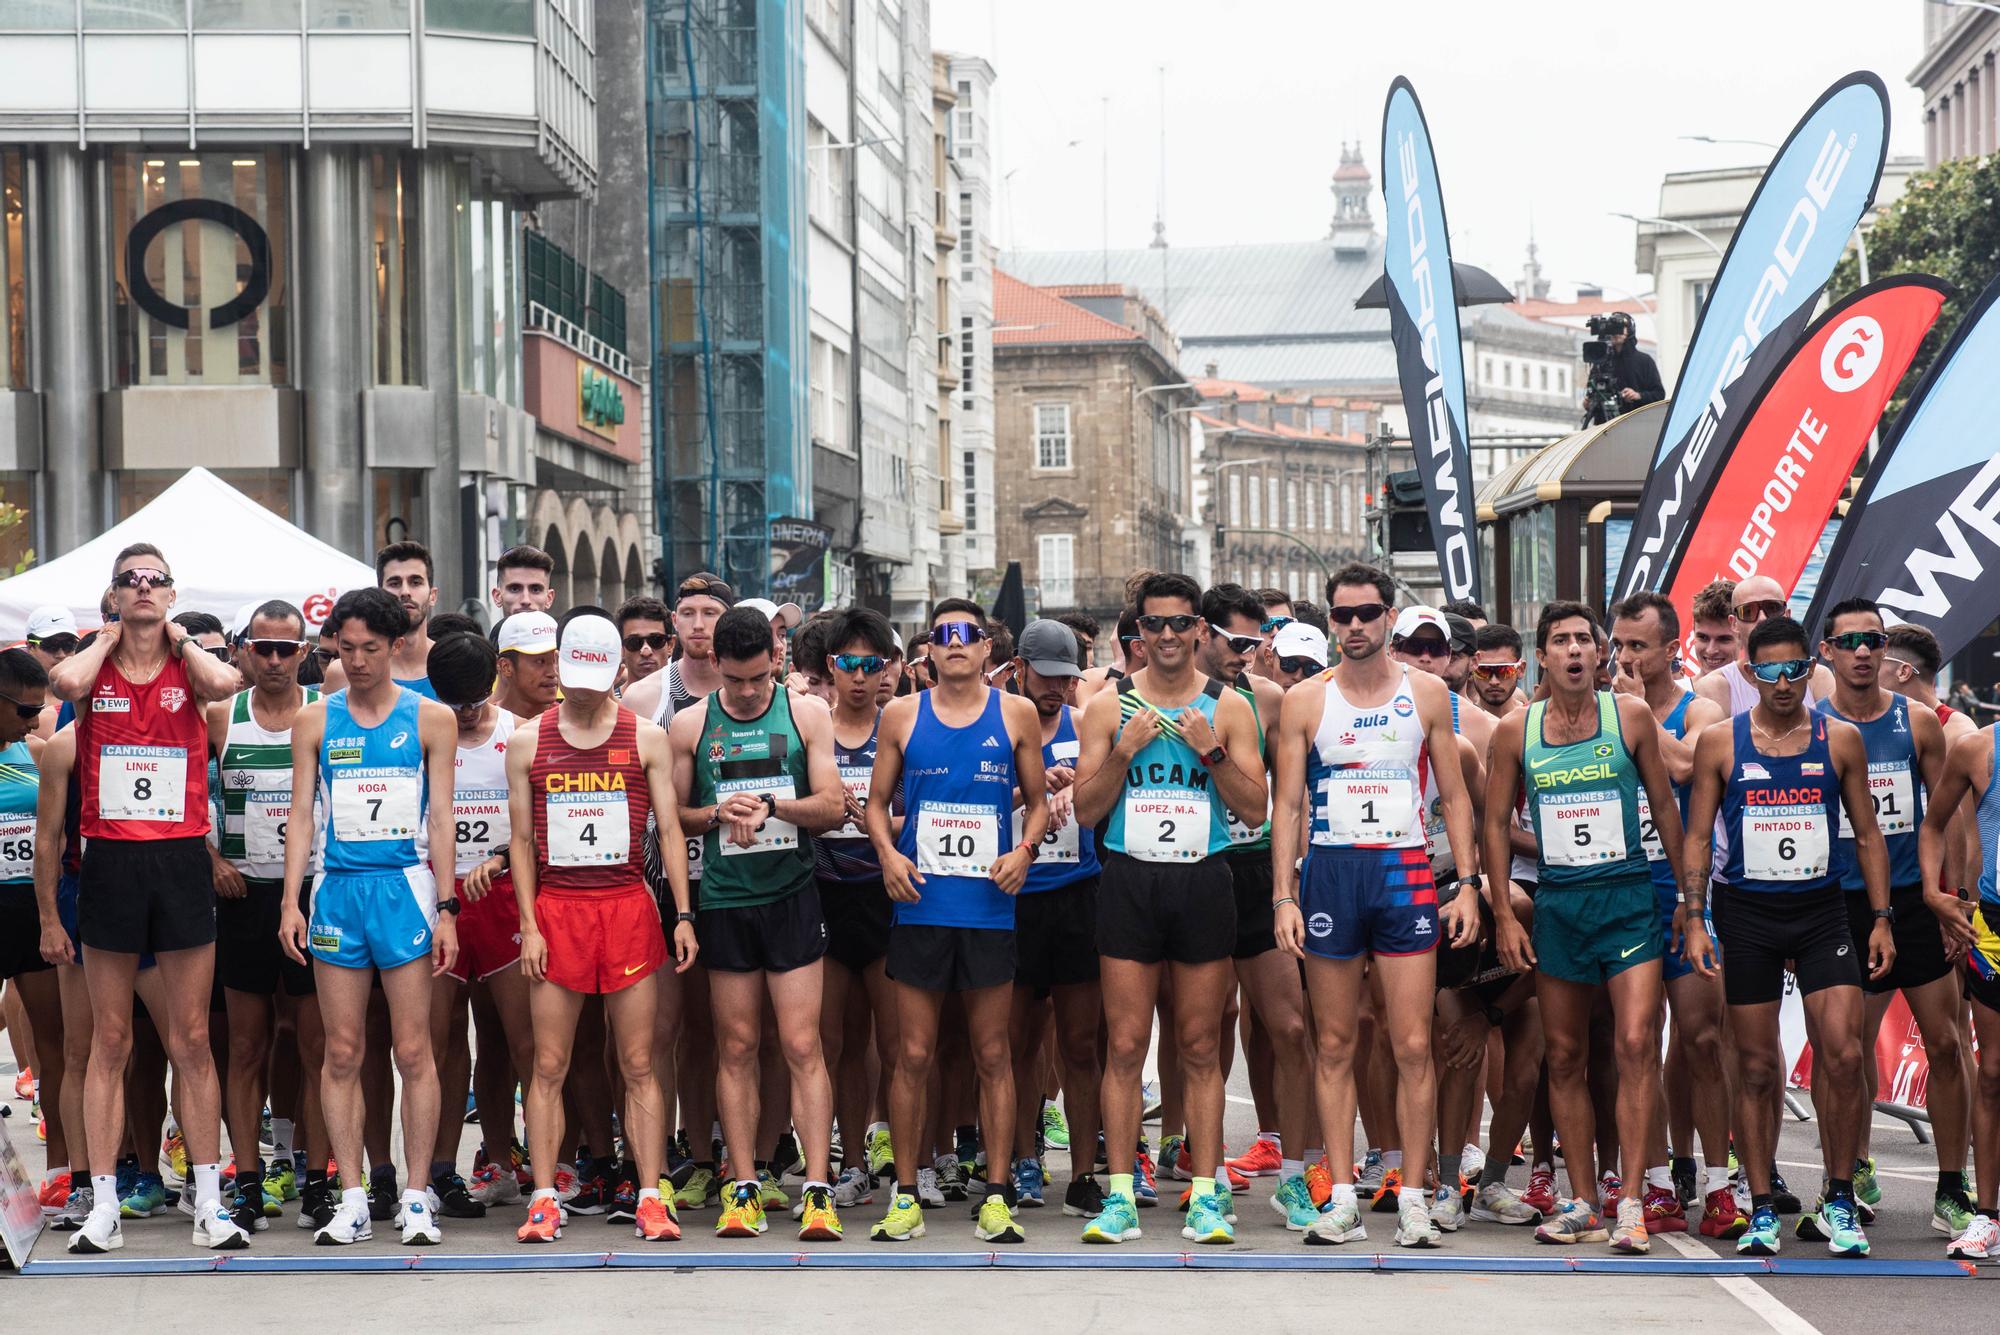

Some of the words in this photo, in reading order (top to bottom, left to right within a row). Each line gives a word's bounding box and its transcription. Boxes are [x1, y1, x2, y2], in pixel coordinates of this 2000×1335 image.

[1624, 129, 1850, 600] OWERADE
[1729, 407, 1828, 581] DEPORTE
[571, 649, 608, 663] CHINA
[107, 699, 129, 708] EWP
[1353, 714, 1389, 728] aula
[731, 729, 756, 738] luanvi
[106, 746, 185, 758] CANTONES23
[126, 762, 158, 772] LINKE
[1334, 769, 1408, 779] CANTONES23
[545, 772, 626, 792] CHINA
[1127, 763, 1209, 791] UCAM
[1534, 763, 1618, 788] BRASIL
[133, 778, 151, 800] 8
[358, 784, 388, 793] KOGA
[719, 776, 792, 792] CANTONES23
[1347, 782, 1389, 794] MARTÍN
[552, 792, 625, 803] CANTONES23
[1131, 789, 1208, 801] CANTONES23
[1542, 790, 1618, 804] CANTONES23
[1746, 788, 1823, 805] ECUADOR
[366, 799, 382, 821] 7
[568, 808, 605, 818] ZHANG
[924, 802, 994, 815] CANTONES23
[1135, 804, 1172, 815] LOPEZ,
[1175, 806, 1198, 815] M.A.
[1361, 800, 1380, 823] 1
[1557, 808, 1600, 819] BONFIM
[1749, 805, 1825, 816] CANTONES23
[931, 818, 981, 829] HURTADO
[1754, 821, 1801, 832] PINTADO
[1805, 822, 1815, 830] B.
[456, 821, 490, 843] 82
[579, 823, 598, 846] 4
[1158, 820, 1176, 843] 2
[1574, 824, 1592, 846] 5
[3, 839, 34, 862] 58
[686, 839, 700, 861] 6
[938, 834, 975, 857] 10
[1778, 837, 1796, 861] 6
